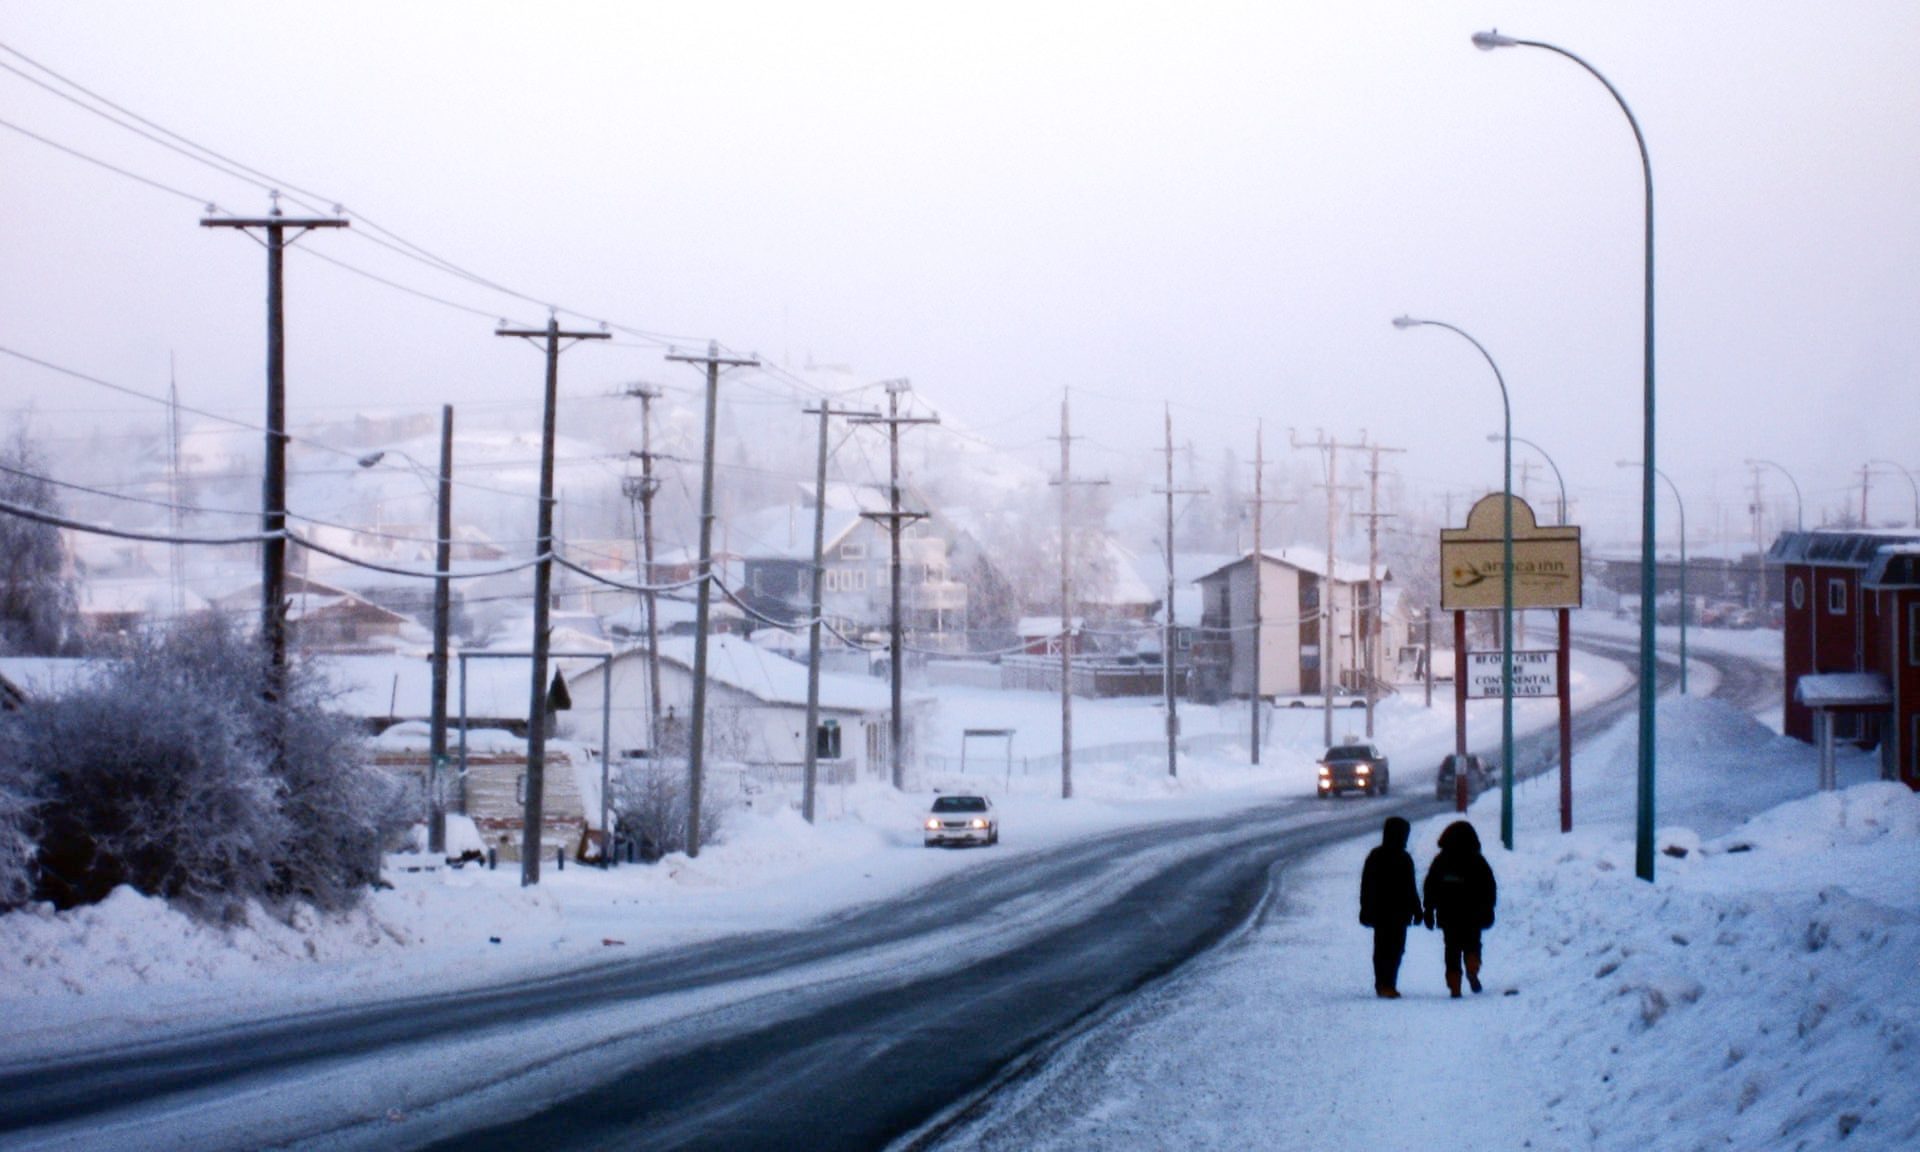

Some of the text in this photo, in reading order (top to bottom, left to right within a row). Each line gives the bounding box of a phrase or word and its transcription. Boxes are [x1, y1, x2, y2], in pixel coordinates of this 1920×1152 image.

[1481, 560, 1535, 572] arca
[1489, 655, 1509, 664] OU
[1475, 675, 1551, 685] CONNENTAL
[1484, 686, 1542, 695] BREFAST
